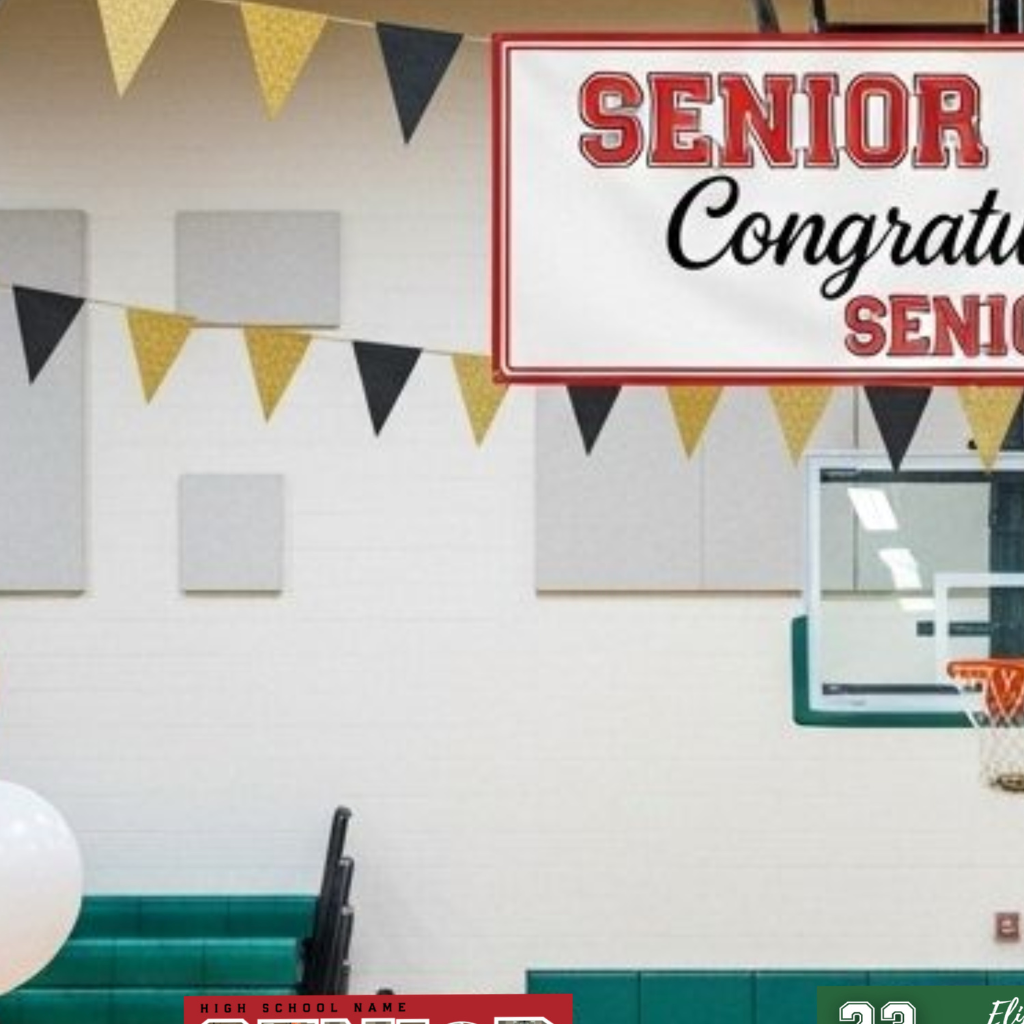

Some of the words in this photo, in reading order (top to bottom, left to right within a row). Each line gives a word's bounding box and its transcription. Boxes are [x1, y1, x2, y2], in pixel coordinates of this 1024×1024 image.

[578, 72, 987, 170] SENIOR
[200, 1003, 247, 1014] HIGH
[262, 1002, 339, 1013] SCHOOL
[353, 1002, 407, 1013] NAME
